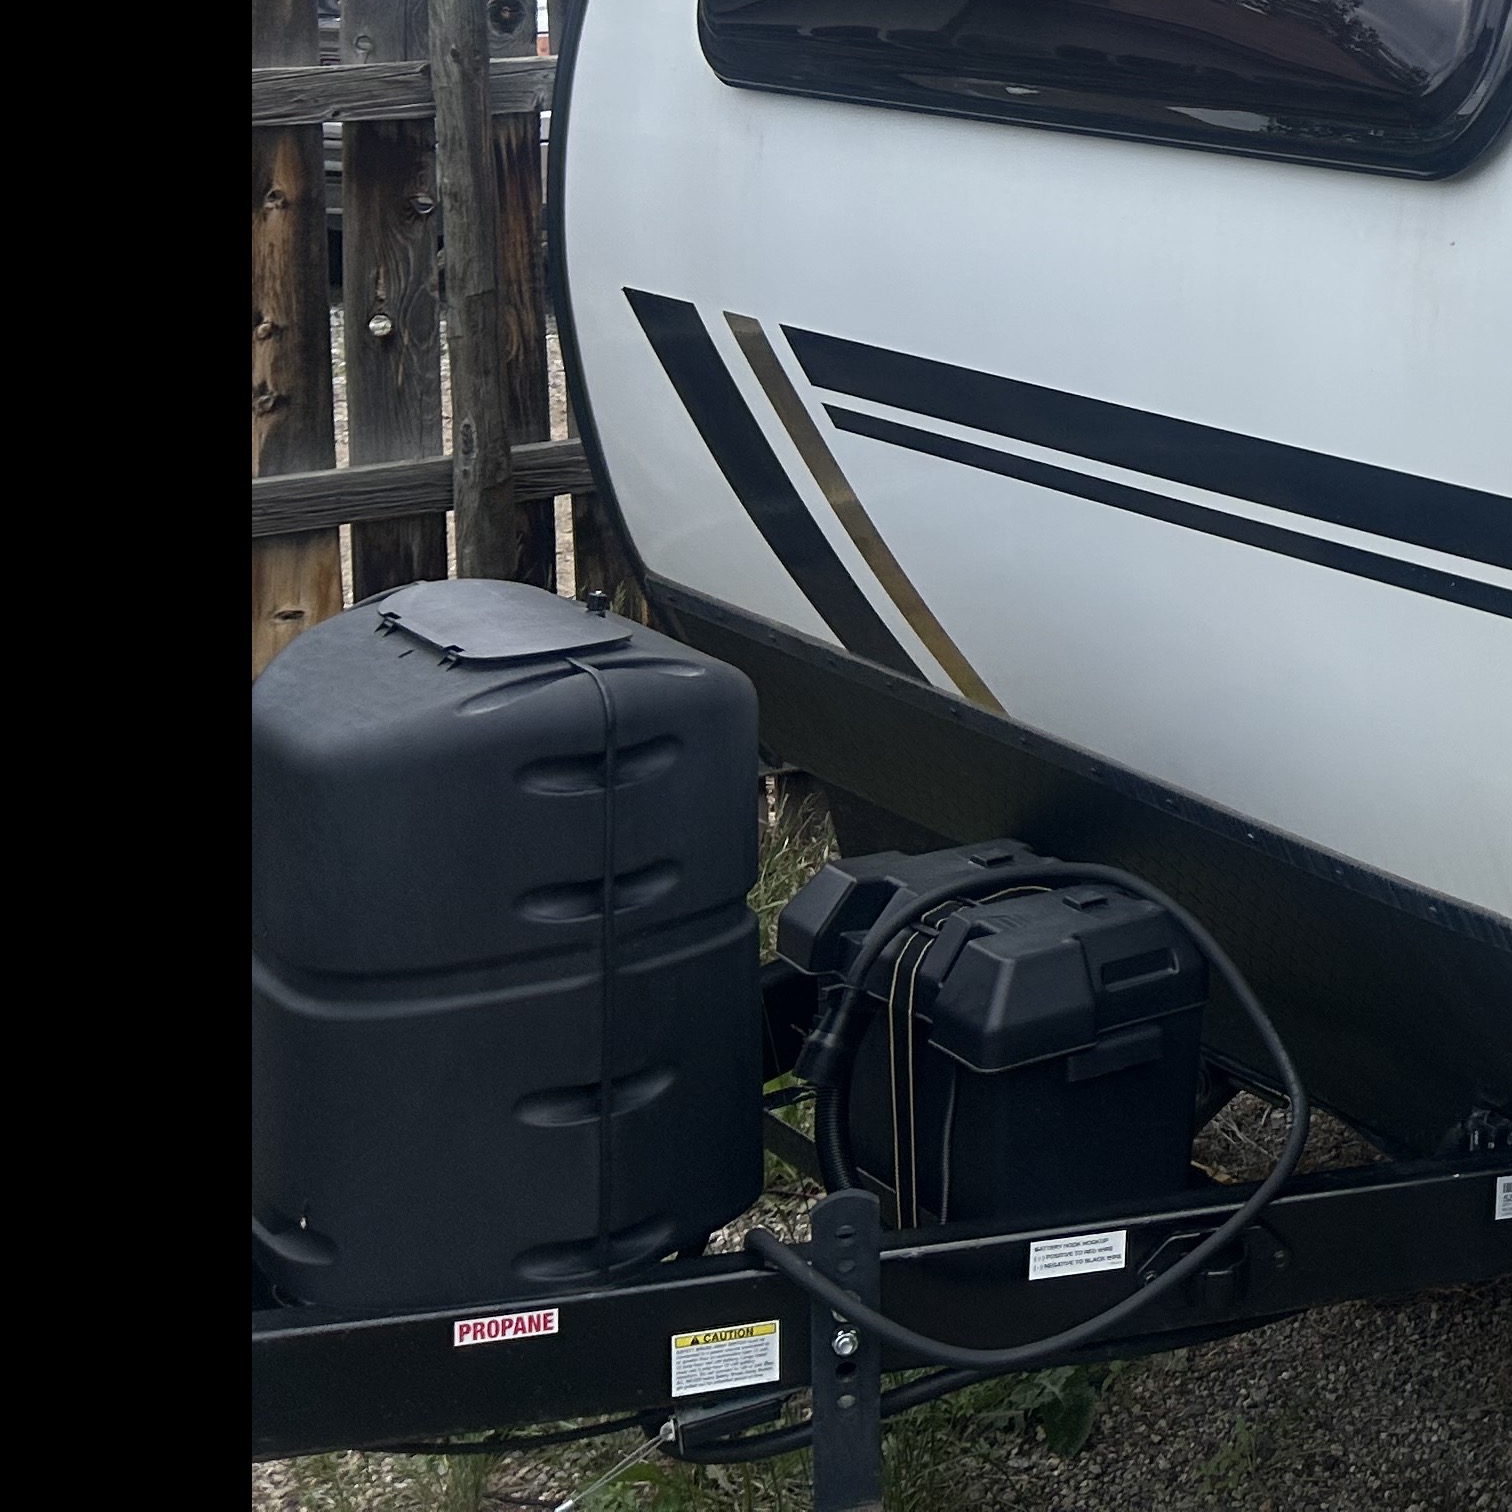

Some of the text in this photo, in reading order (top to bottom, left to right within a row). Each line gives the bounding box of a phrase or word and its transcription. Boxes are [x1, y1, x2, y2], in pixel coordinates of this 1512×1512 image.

[1085, 1255, 1105, 1264] BLACK
[459, 1312, 554, 1343] PROPANE
[703, 1327, 754, 1343] CAUTION
